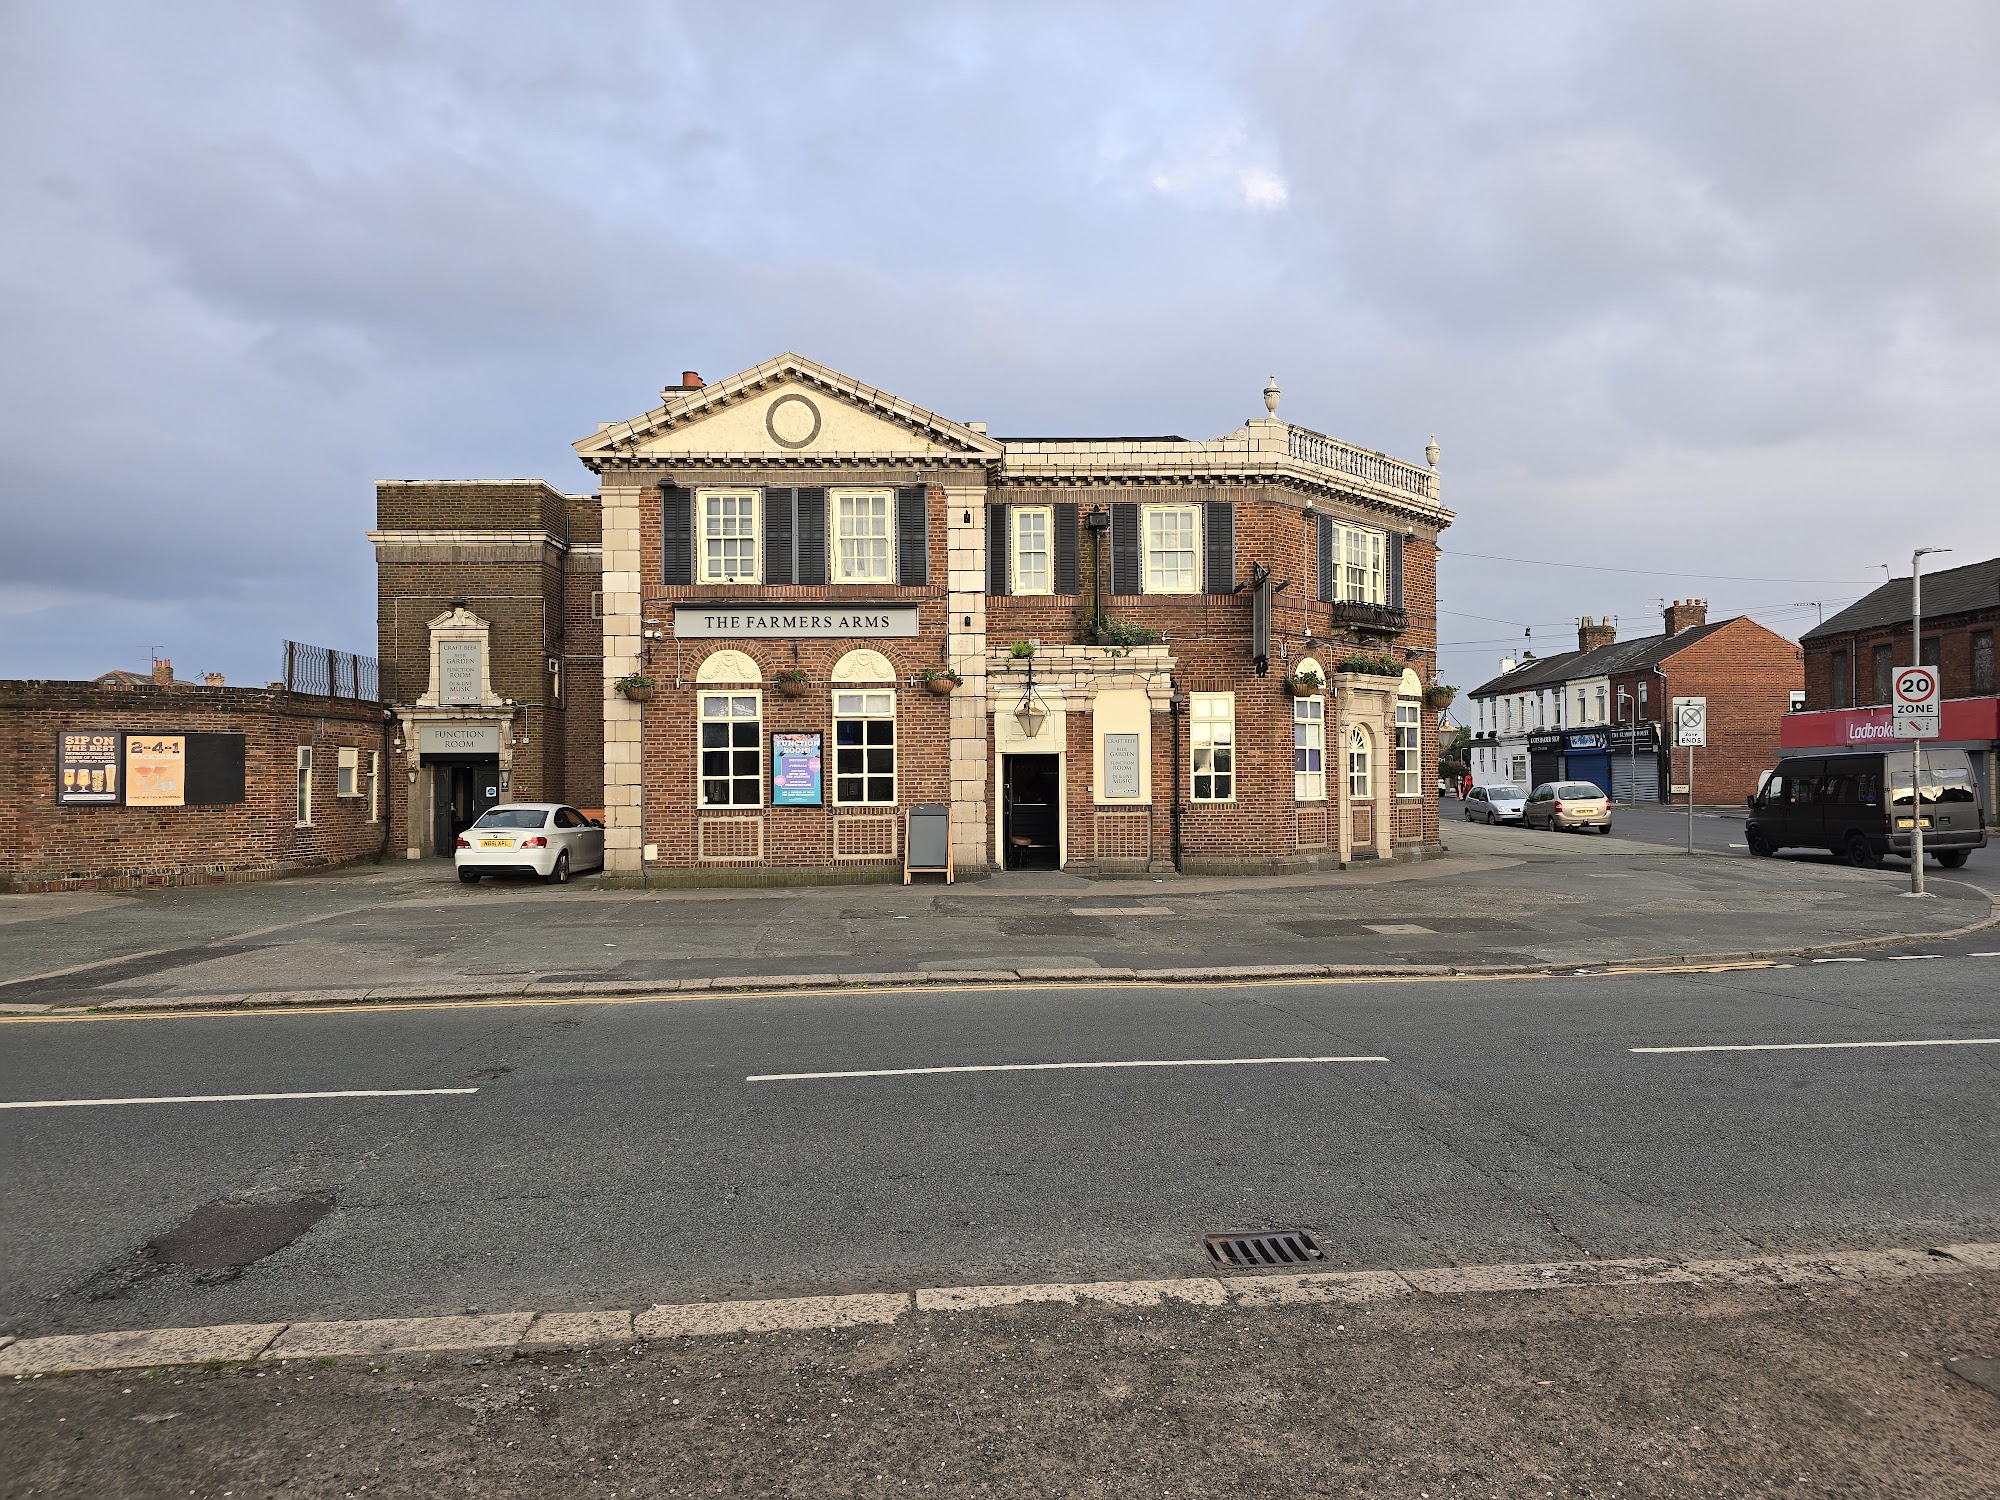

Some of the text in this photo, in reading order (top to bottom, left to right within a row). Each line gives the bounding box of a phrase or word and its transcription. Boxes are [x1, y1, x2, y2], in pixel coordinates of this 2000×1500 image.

[705, 615, 890, 628] THE FARMERS ARMS
[1902, 678, 1930, 693] 20
[1897, 704, 1934, 714] ZONE
[434, 730, 485, 739] FUNCTION
[1849, 721, 1893, 739] Ladbroke
[65, 736, 115, 746] SIP ON
[445, 740, 475, 748] ROOM
[131, 741, 180, 754] 2-4-1
